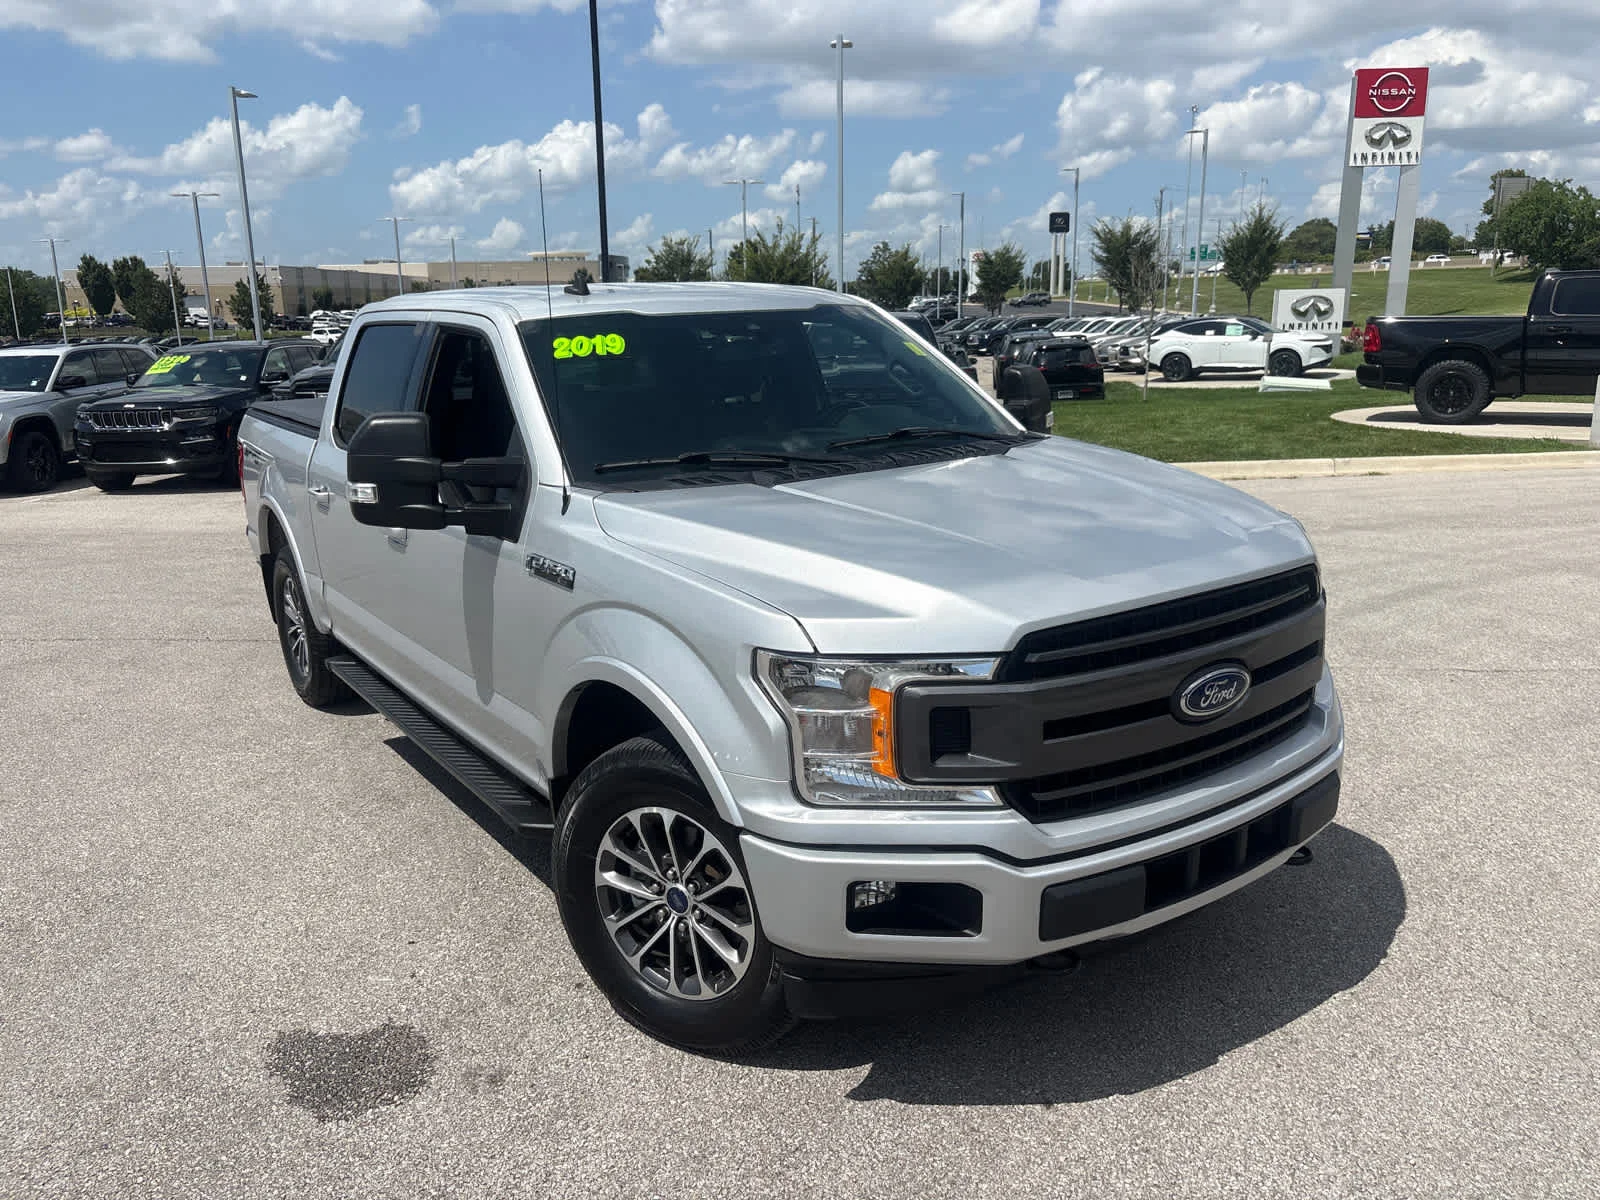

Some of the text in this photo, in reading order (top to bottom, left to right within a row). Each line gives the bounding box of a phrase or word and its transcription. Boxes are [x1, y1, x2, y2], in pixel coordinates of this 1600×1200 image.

[1368, 88, 1416, 96] NISSAN
[1353, 151, 1420, 165] INFINITI
[1282, 321, 1339, 331] INFINITI
[552, 333, 626, 359] 2019
[1200, 679, 1238, 708] Ford
